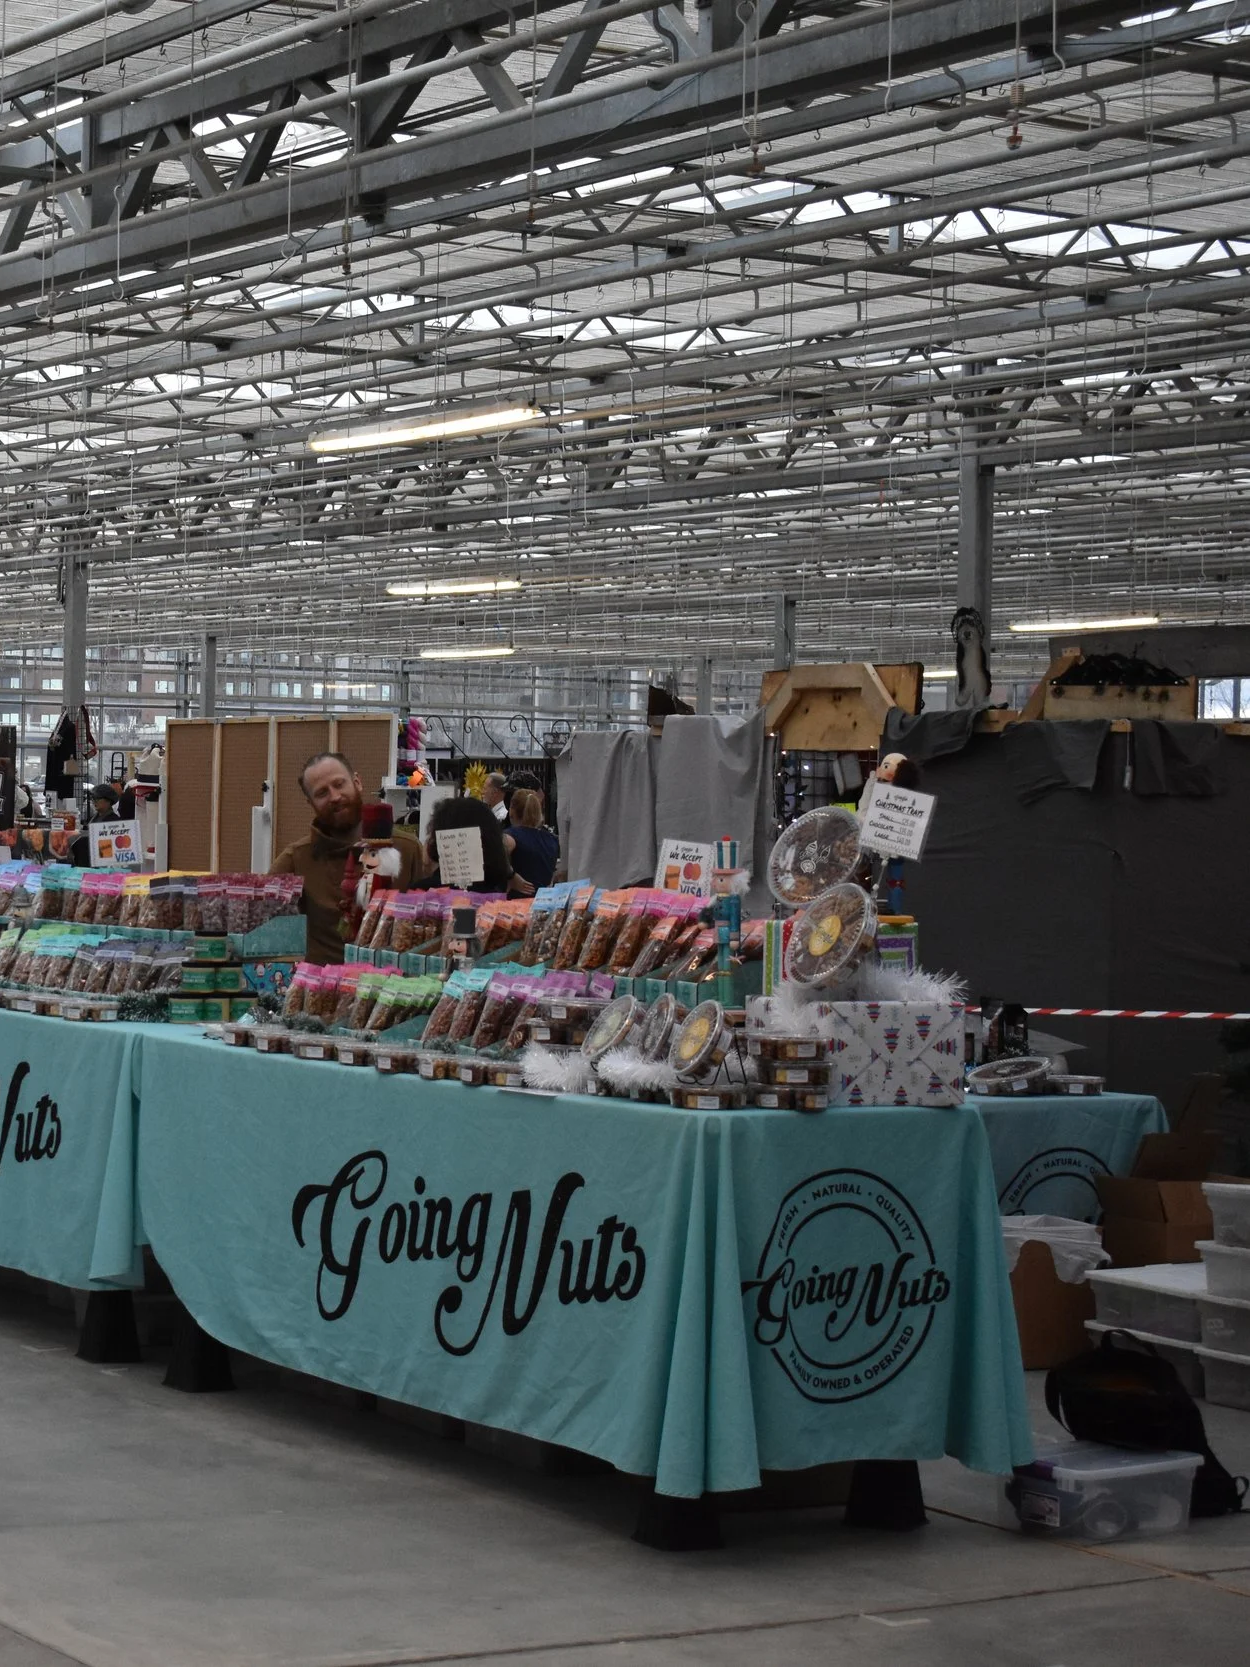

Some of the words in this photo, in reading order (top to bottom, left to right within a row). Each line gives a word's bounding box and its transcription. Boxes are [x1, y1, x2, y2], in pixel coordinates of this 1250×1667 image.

[115, 852, 136, 862] VISA
[680, 884, 702, 898] VISA
[1043, 1158, 1082, 1170] NATURAL
[777, 1205, 799, 1249] FRESH
[812, 1183, 862, 1201] NATURAL
[876, 1195, 915, 1242] QUALITY
[292, 1150, 492, 1321] Going
[434, 1172, 646, 1356] Nuts
[740, 1258, 859, 1345] Going
[825, 1252, 950, 1342] Nuts
[789, 1350, 812, 1384] FAMILY
[813, 1377, 851, 1390] OWNED
[854, 1374, 862, 1385] &
[865, 1325, 915, 1380] OPERATED
